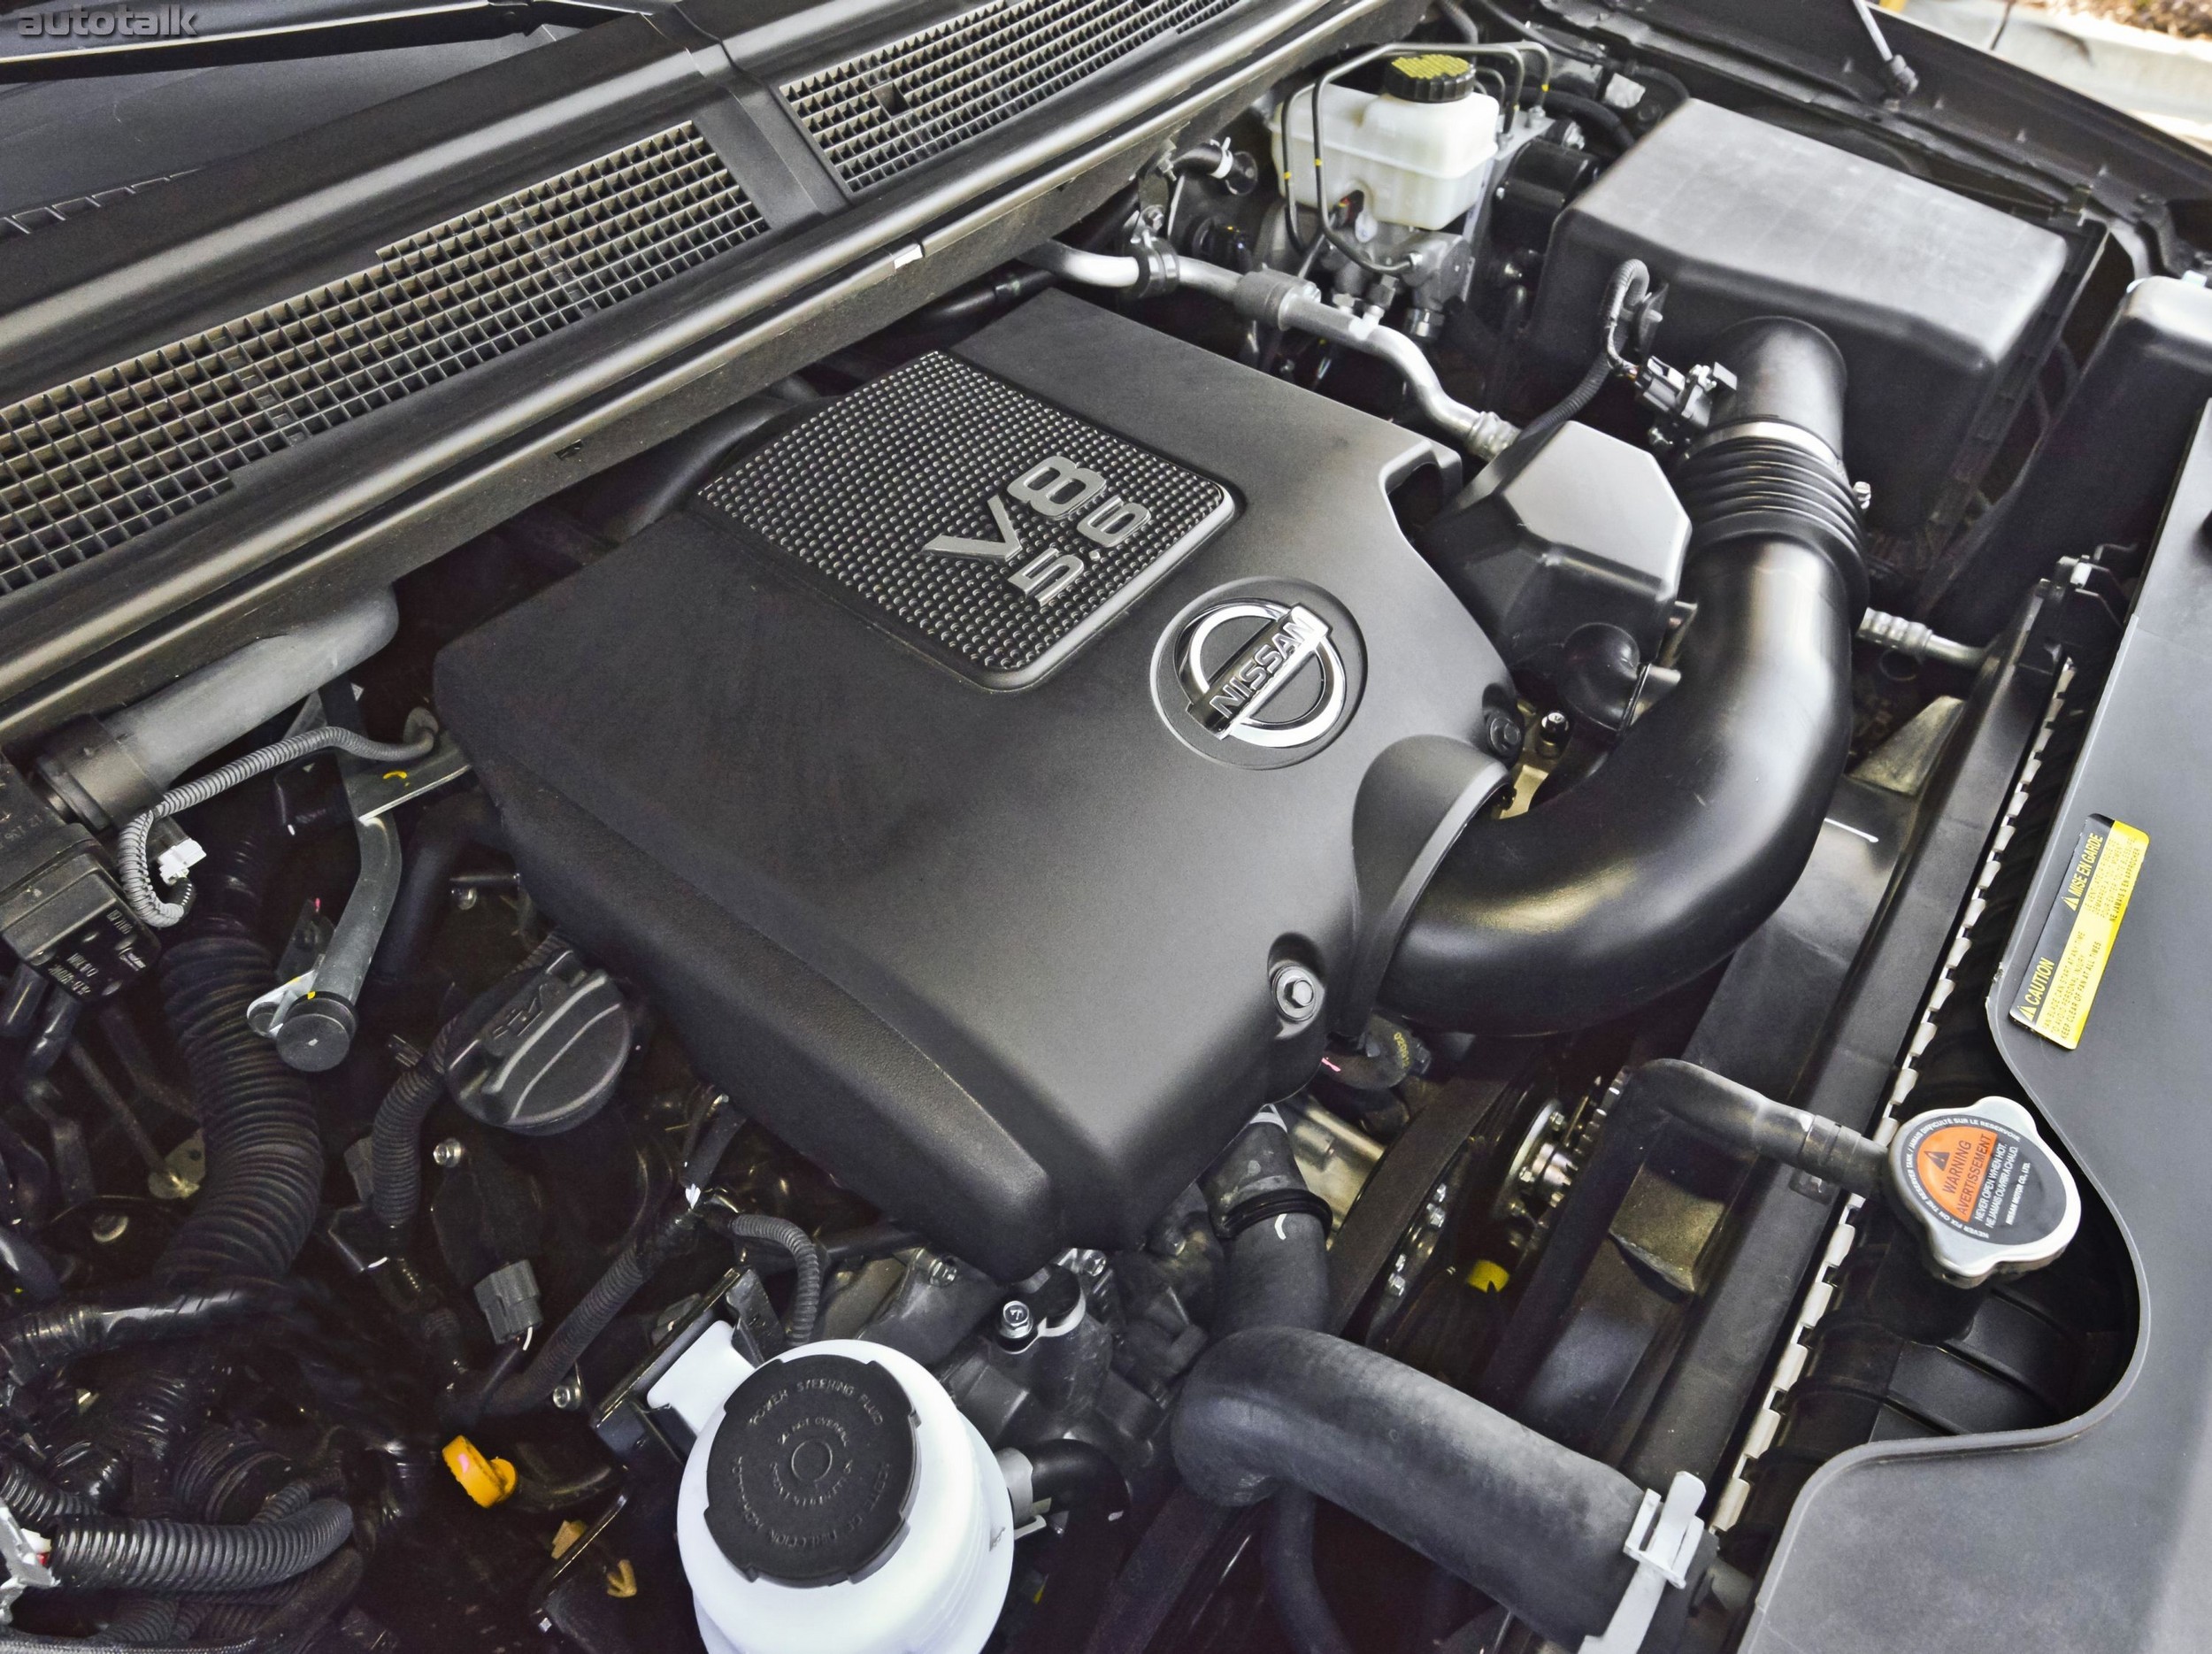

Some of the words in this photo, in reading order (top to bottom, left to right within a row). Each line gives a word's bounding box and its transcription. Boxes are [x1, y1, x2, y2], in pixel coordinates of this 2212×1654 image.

[923, 456, 1107, 561] V8
[1008, 495, 1151, 607] 5.6
[1210, 616, 1315, 718] NISSAN
[2082, 832, 2103, 863] GARDE
[2077, 860, 2092, 876] EN
[2124, 848, 2140, 878] APPROCHER
[2068, 873, 2087, 897] MISE
[2112, 892, 2125, 913] JAMAIS
[2108, 913, 2117, 922] NE
[2089, 941, 2101, 958] TIMES
[2059, 965, 2072, 984] START
[2085, 958, 2095, 971] ALL
[2024, 957, 2055, 1005] CAUTION
[2055, 1006, 2067, 1026] AVOID
[2061, 975, 2078, 1006] PERSONAL
[2072, 954, 2086, 974] INJURY
[2055, 984, 2065, 997] CAN
[2077, 979, 2087, 992] FAN
[2047, 997, 2061, 1018] BLADE
[2066, 1001, 2079, 1023] CLEAR
[2060, 1022, 2072, 1040] KEEP
[1996, 1142, 2008, 1159] HOT.
[1942, 1140, 1971, 1194] WARNING
[1956, 1134, 1992, 1215] AVERTISSEMENT
[1988, 1158, 2002, 1179] WHEN
[1982, 1179, 1995, 1197] OPEN
[1926, 1199, 1939, 1212] THE
[1975, 1197, 1989, 1221] NEVER
[1988, 1196, 2002, 1220] JAMAIS
[2006, 1203, 2017, 1225] NISSAN
[2012, 1184, 2024, 1204] MOTOR
[1939, 1212, 1950, 1220] ON
[1963, 1225, 1989, 1239] NEVER
[747, 1389, 788, 1425] POWER
[796, 1379, 856, 1396] STEERING
[857, 1393, 883, 1426] FLUID
